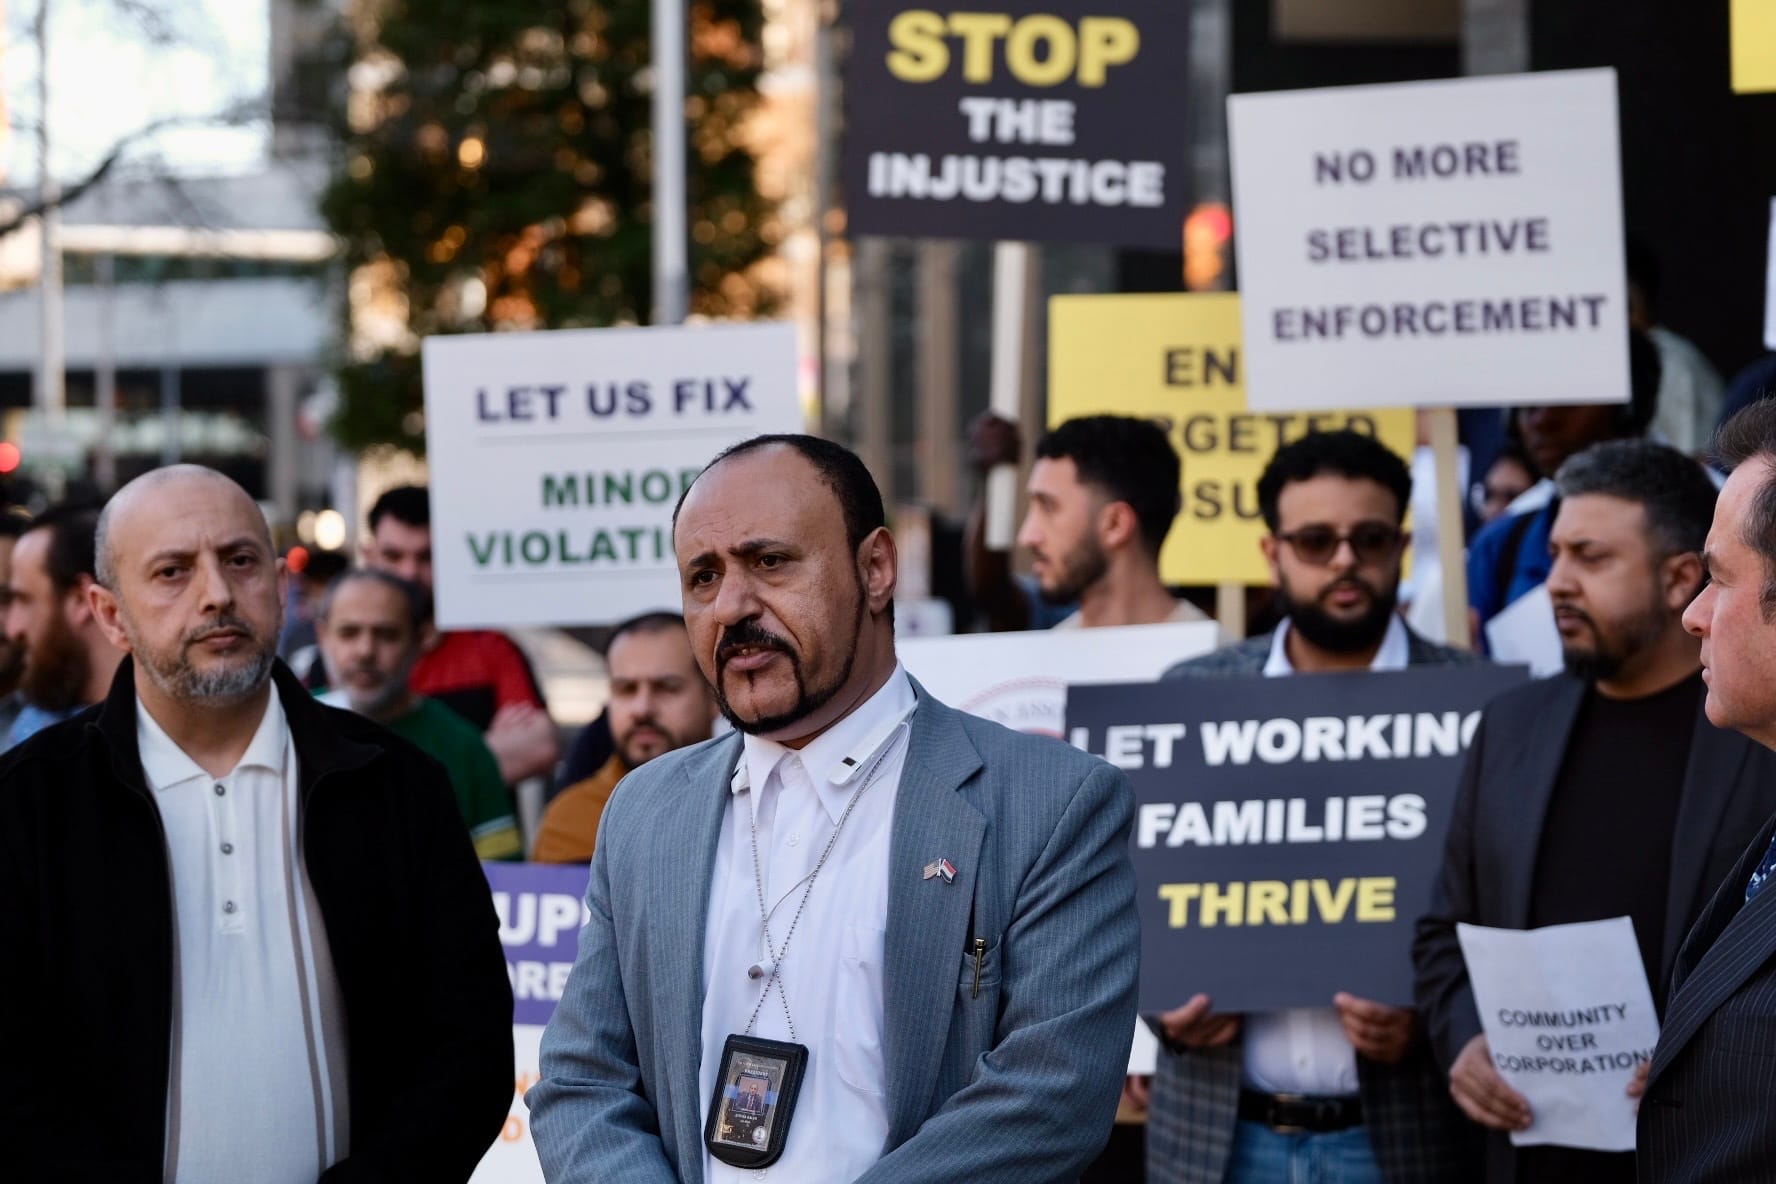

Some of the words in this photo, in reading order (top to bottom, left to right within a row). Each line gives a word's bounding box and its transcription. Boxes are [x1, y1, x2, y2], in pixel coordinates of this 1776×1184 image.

[886, 10, 1140, 88] STOP
[960, 97, 1076, 145] THE
[868, 153, 1165, 206] INJUSTICE
[1315, 150, 1375, 185] NO
[1393, 140, 1521, 180] MORE
[1307, 218, 1551, 263] SELECTIVE
[1272, 295, 1608, 342] ENFORCEMENT
[475, 387, 565, 424] LET
[588, 381, 655, 419] US
[673, 376, 754, 416] FIX
[466, 525, 675, 566] VIOLATI
[1137, 793, 1428, 849] FAMILIES
[1158, 876, 1397, 929] THRIVE
[1499, 1003, 1627, 1027] COMMUNITY
[1537, 1032, 1598, 1051] OVER
